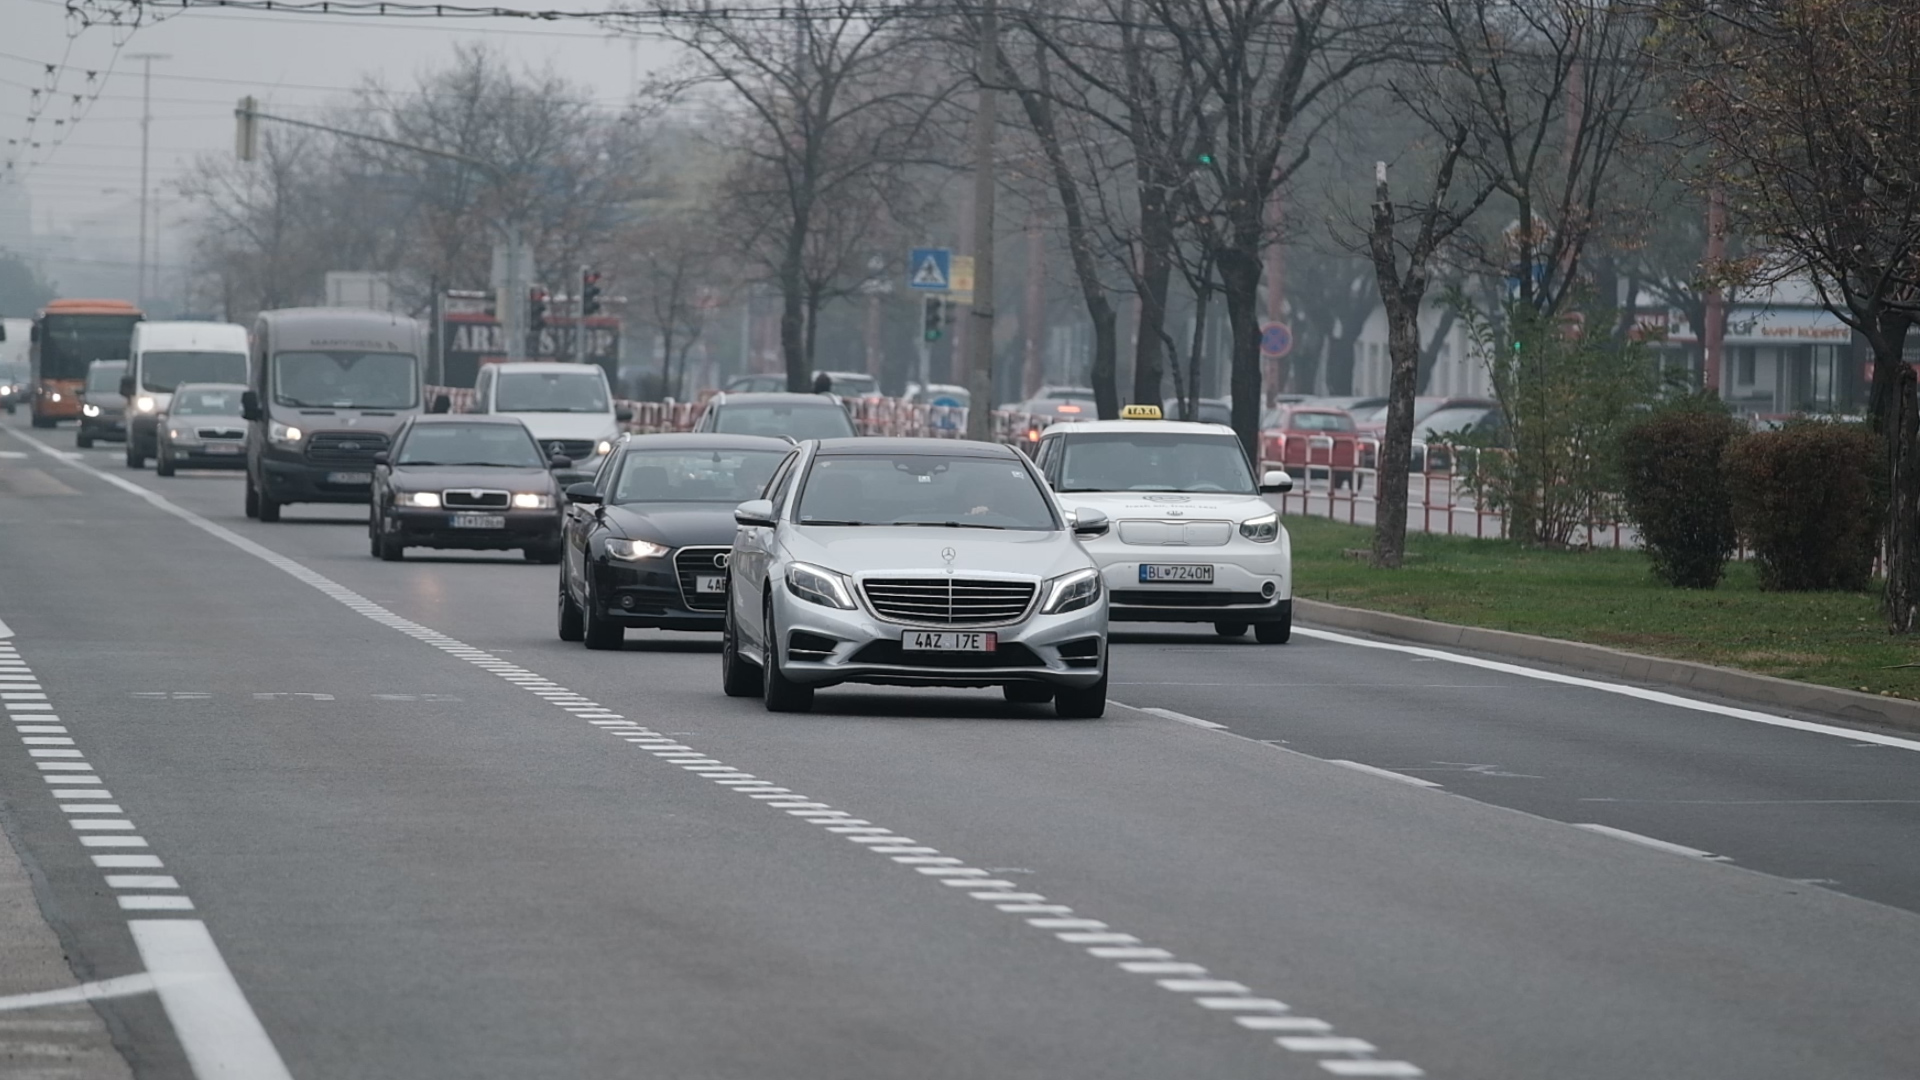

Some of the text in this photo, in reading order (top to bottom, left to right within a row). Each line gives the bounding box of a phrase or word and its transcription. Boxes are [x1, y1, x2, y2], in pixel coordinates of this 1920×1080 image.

[1128, 407, 1156, 415] TAXI
[915, 633, 980, 649] 4AZ 17E
